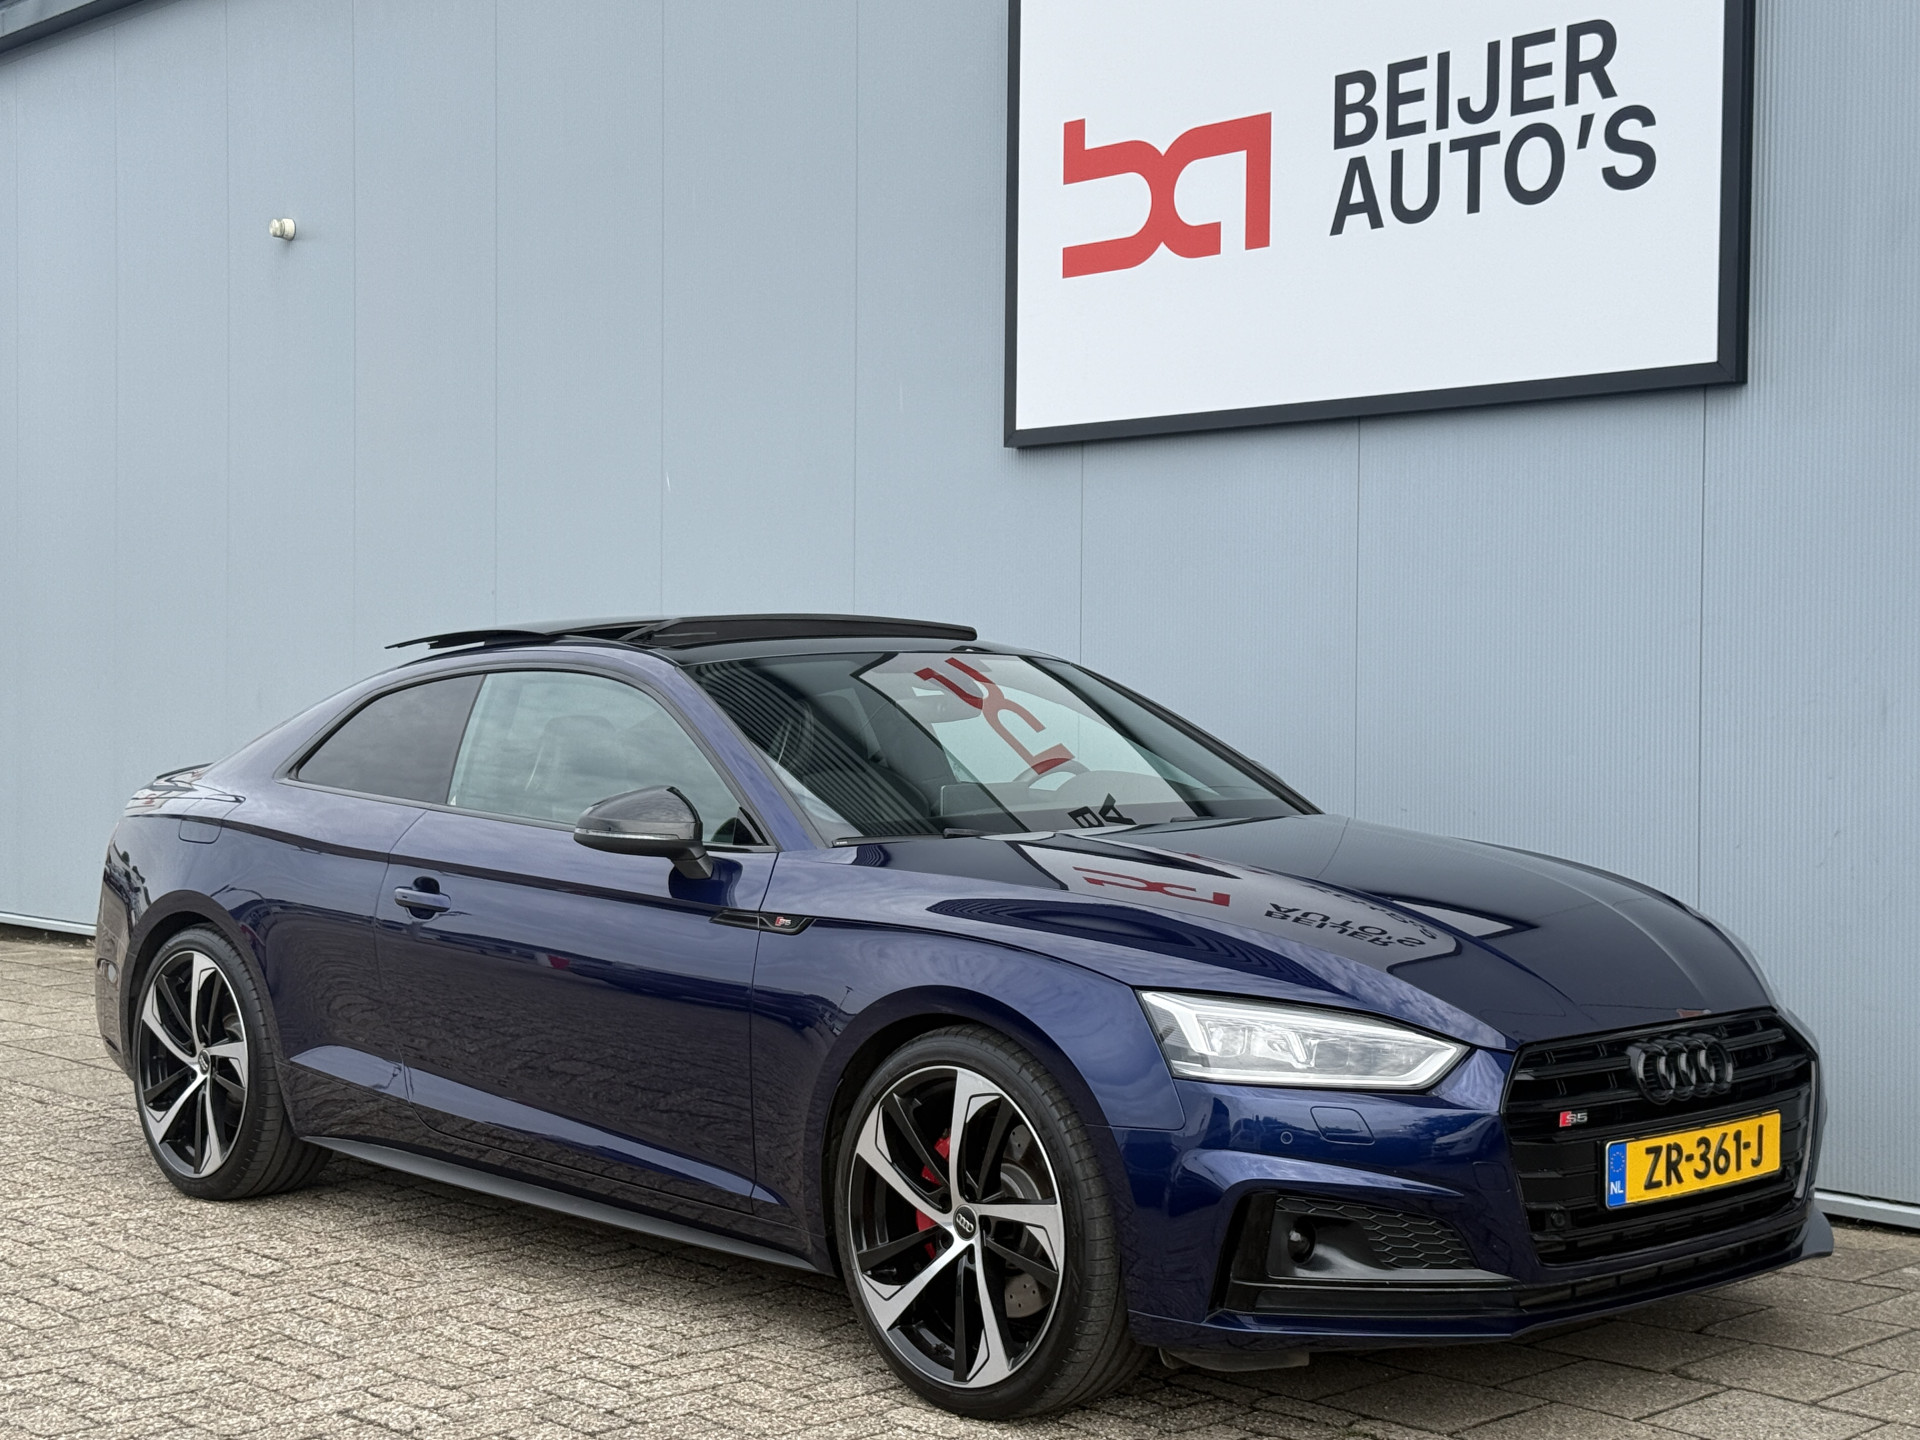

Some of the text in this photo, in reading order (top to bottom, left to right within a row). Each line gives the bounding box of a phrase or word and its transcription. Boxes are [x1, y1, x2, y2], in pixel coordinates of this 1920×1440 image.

[1333, 18, 1618, 151] BEIJER
[1329, 104, 1658, 237] AUTO'S
[1563, 1112, 1588, 1125] S5
[1609, 1180, 1624, 1195] NL
[1643, 1124, 1764, 1190] ZR-361-J
